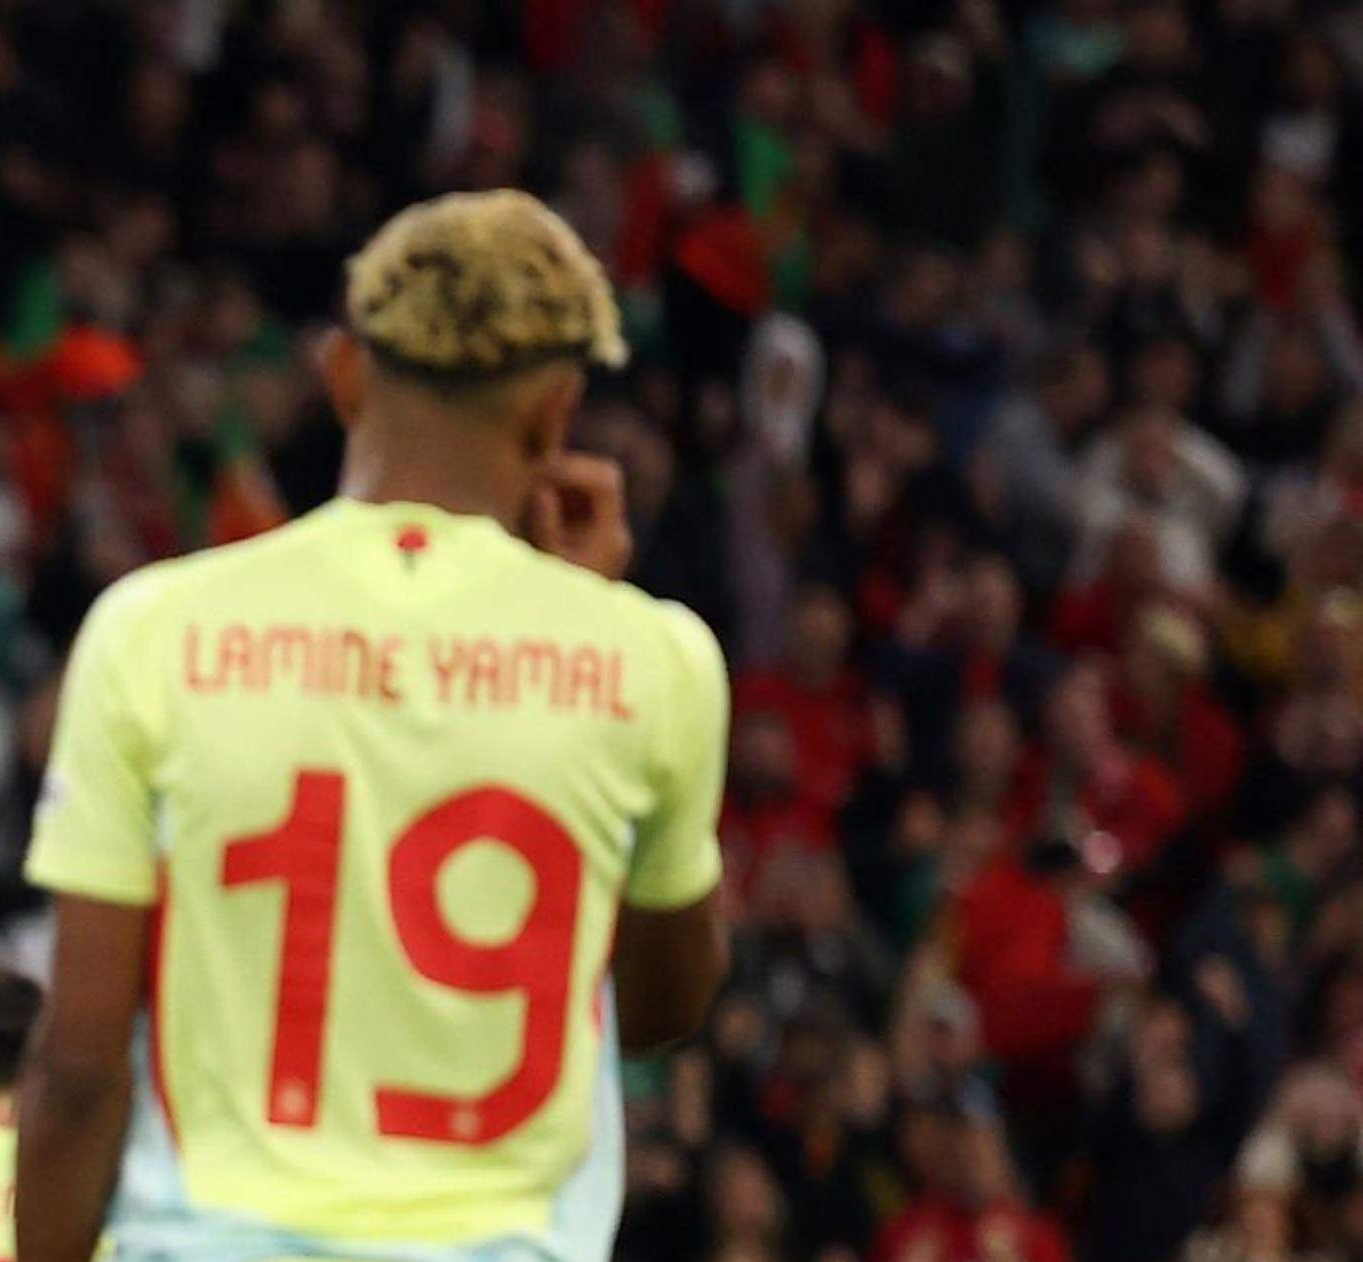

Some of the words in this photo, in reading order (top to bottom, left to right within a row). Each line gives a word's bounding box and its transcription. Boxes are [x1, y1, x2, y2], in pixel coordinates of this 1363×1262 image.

[184, 624, 403, 704] LAMINE
[429, 634, 633, 720] YAMAL
[220, 769, 584, 1150] 19
